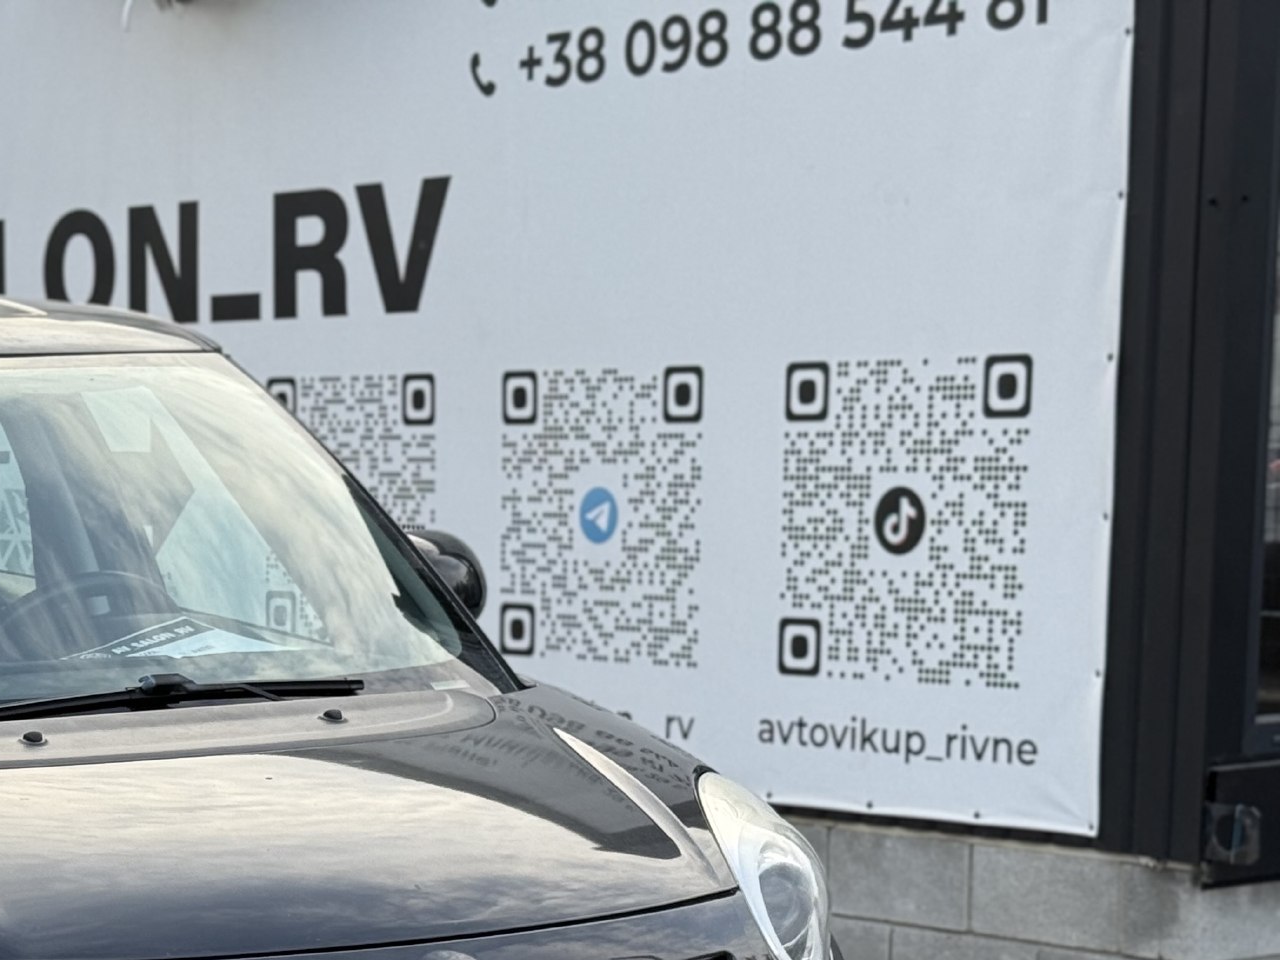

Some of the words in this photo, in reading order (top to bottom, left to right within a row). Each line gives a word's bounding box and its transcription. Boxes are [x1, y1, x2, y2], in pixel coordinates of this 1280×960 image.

[519, 26, 606, 88] +38
[624, 8, 729, 77] 098
[748, 0, 823, 61] 88
[841, 0, 965, 49] 544
[757, 716, 1039, 766] avtovikup_rivne
